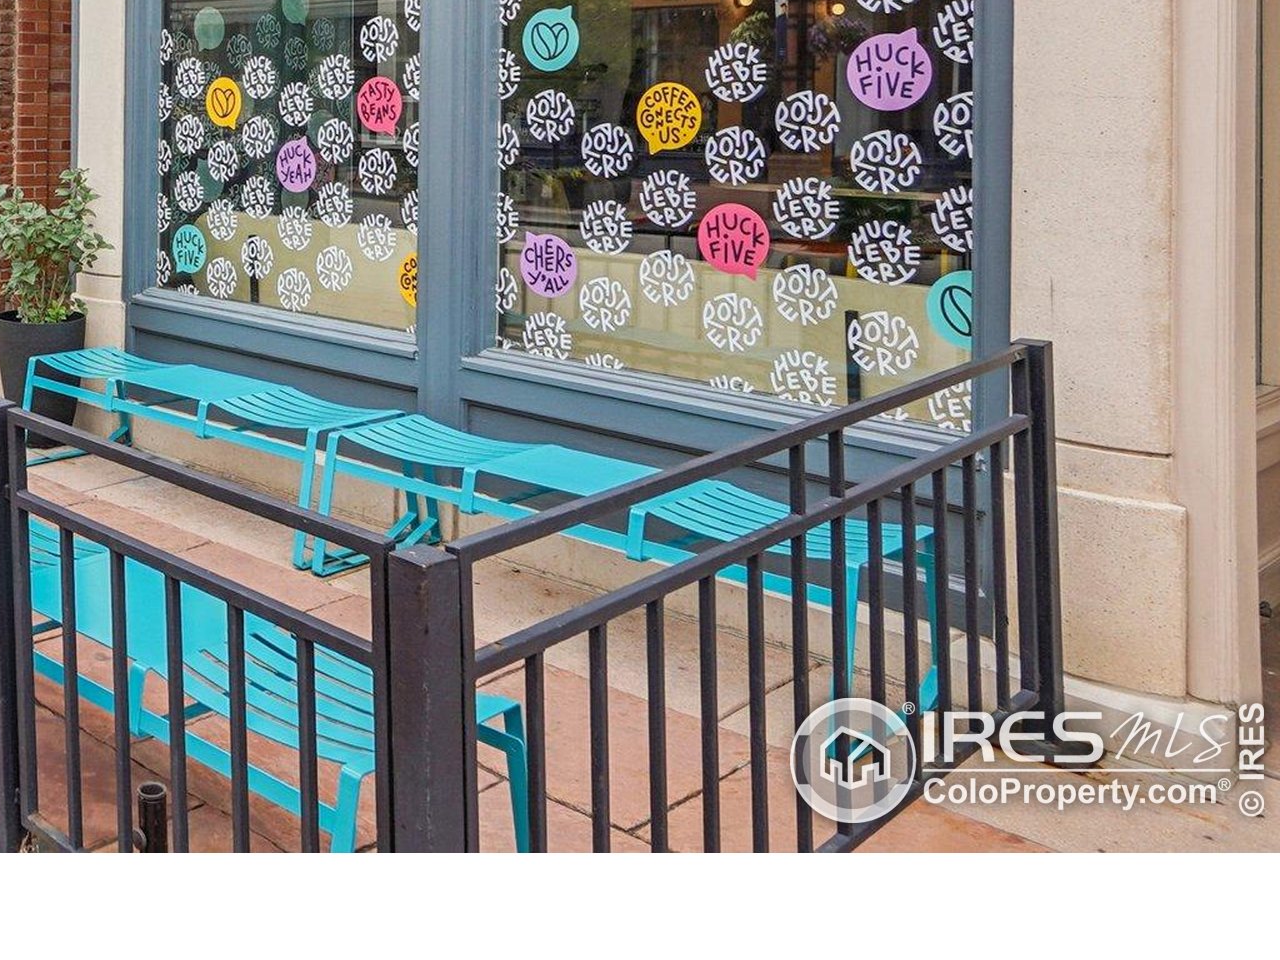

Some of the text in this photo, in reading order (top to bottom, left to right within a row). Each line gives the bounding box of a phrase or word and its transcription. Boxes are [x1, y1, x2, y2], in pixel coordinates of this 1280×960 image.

[856, 43, 925, 80] HUCK
[360, 81, 395, 105] TASTY
[645, 86, 697, 113] COFFEE
[361, 103, 397, 126] BEANS
[659, 129, 680, 144] US
[281, 146, 312, 169] HUCK
[281, 168, 312, 184] YEAH
[706, 212, 765, 247] HUCK
[176, 231, 205, 255] HUCK
